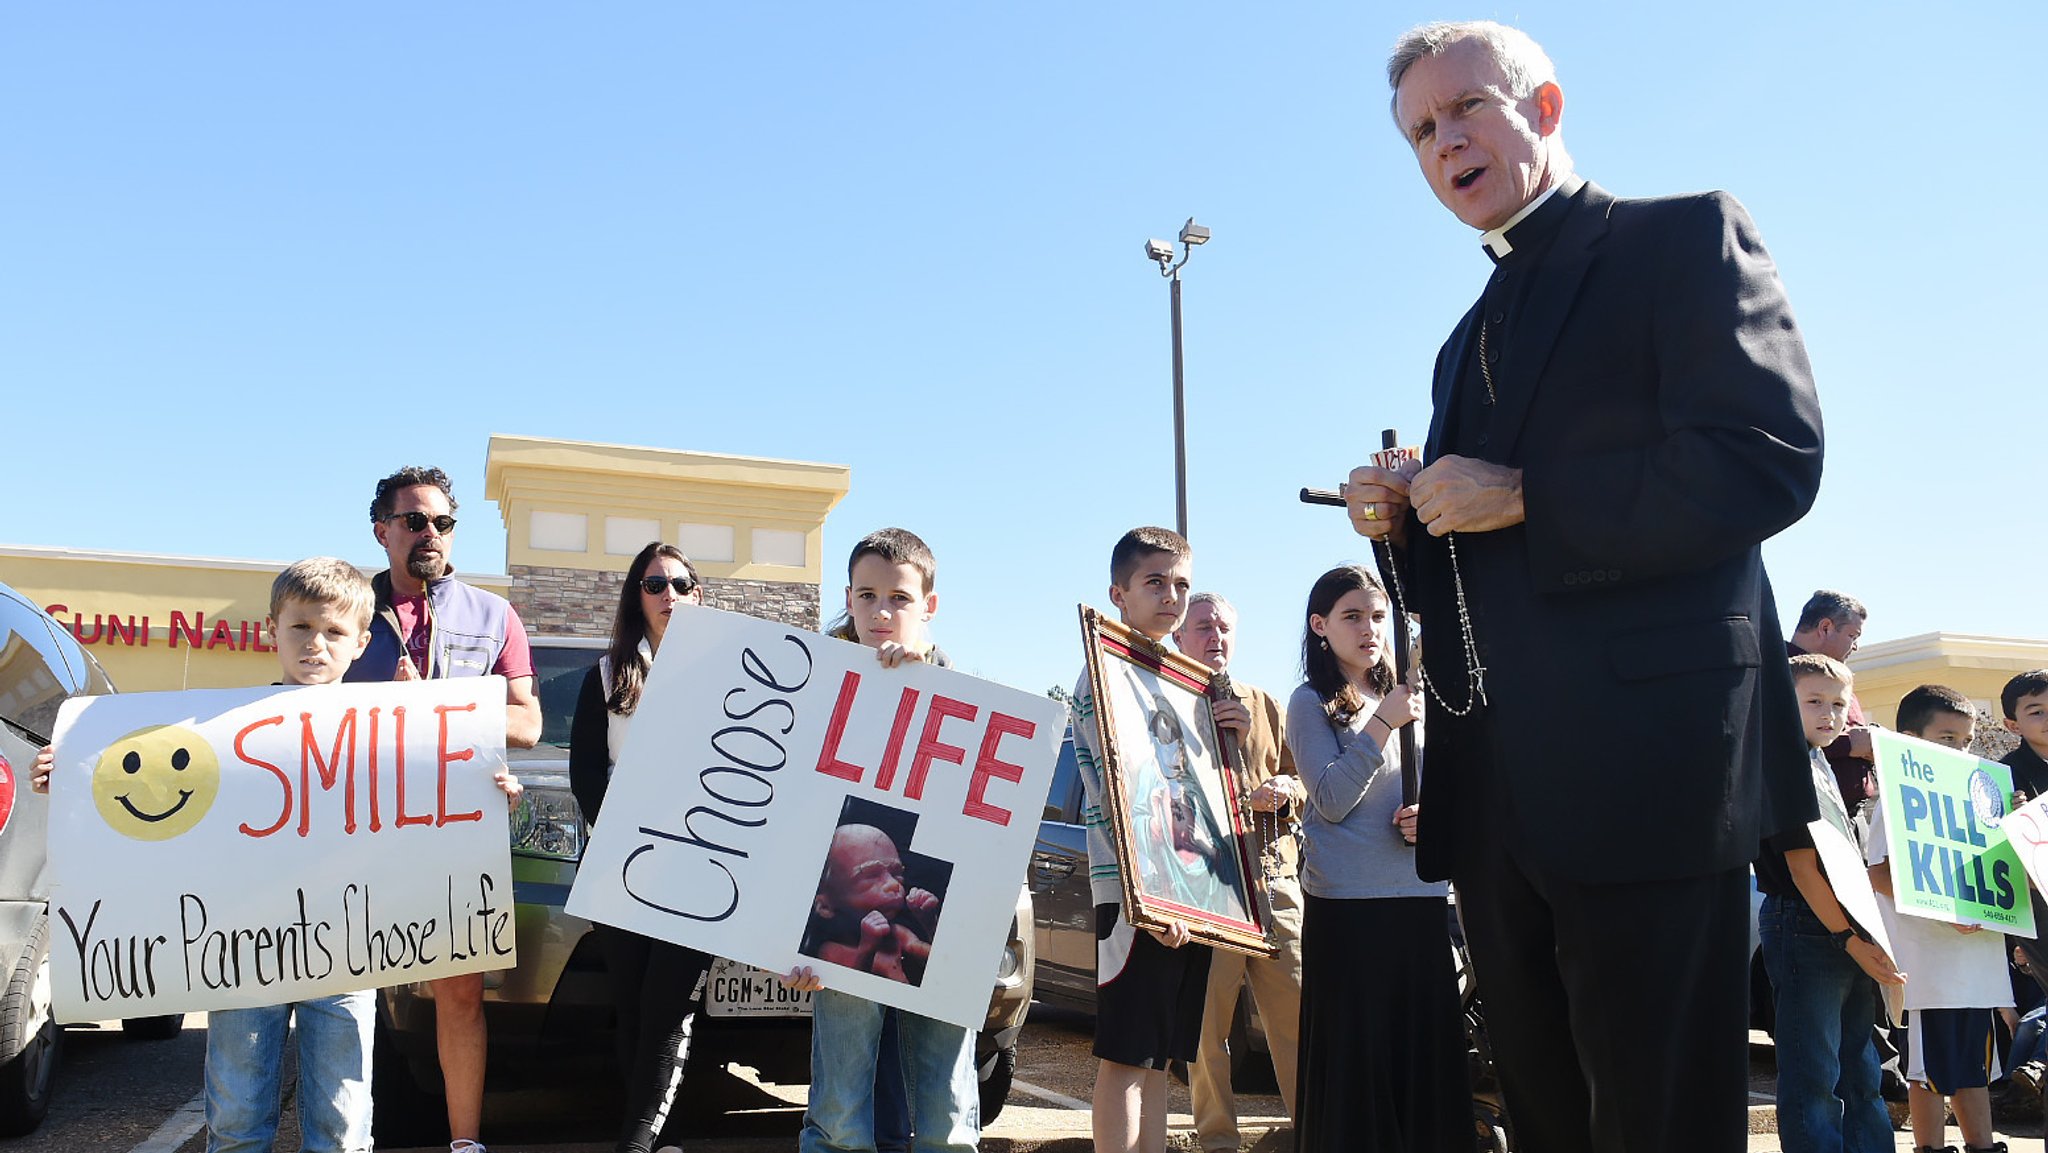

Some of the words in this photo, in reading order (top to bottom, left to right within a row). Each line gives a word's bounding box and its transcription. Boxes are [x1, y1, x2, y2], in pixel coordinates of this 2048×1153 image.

[168, 610, 278, 653] NAIL
[234, 703, 483, 837] SMILE
[622, 634, 813, 922] Choose
[815, 670, 1037, 826] LIFE
[1901, 749, 1935, 784] the
[1900, 784, 1987, 848] PILL
[1907, 839, 2015, 911] KILLS
[58, 899, 167, 1003] Your
[180, 888, 334, 992] Parents
[343, 884, 438, 974] Chose
[448, 874, 514, 961] Life
[714, 977, 753, 1003] CGM
